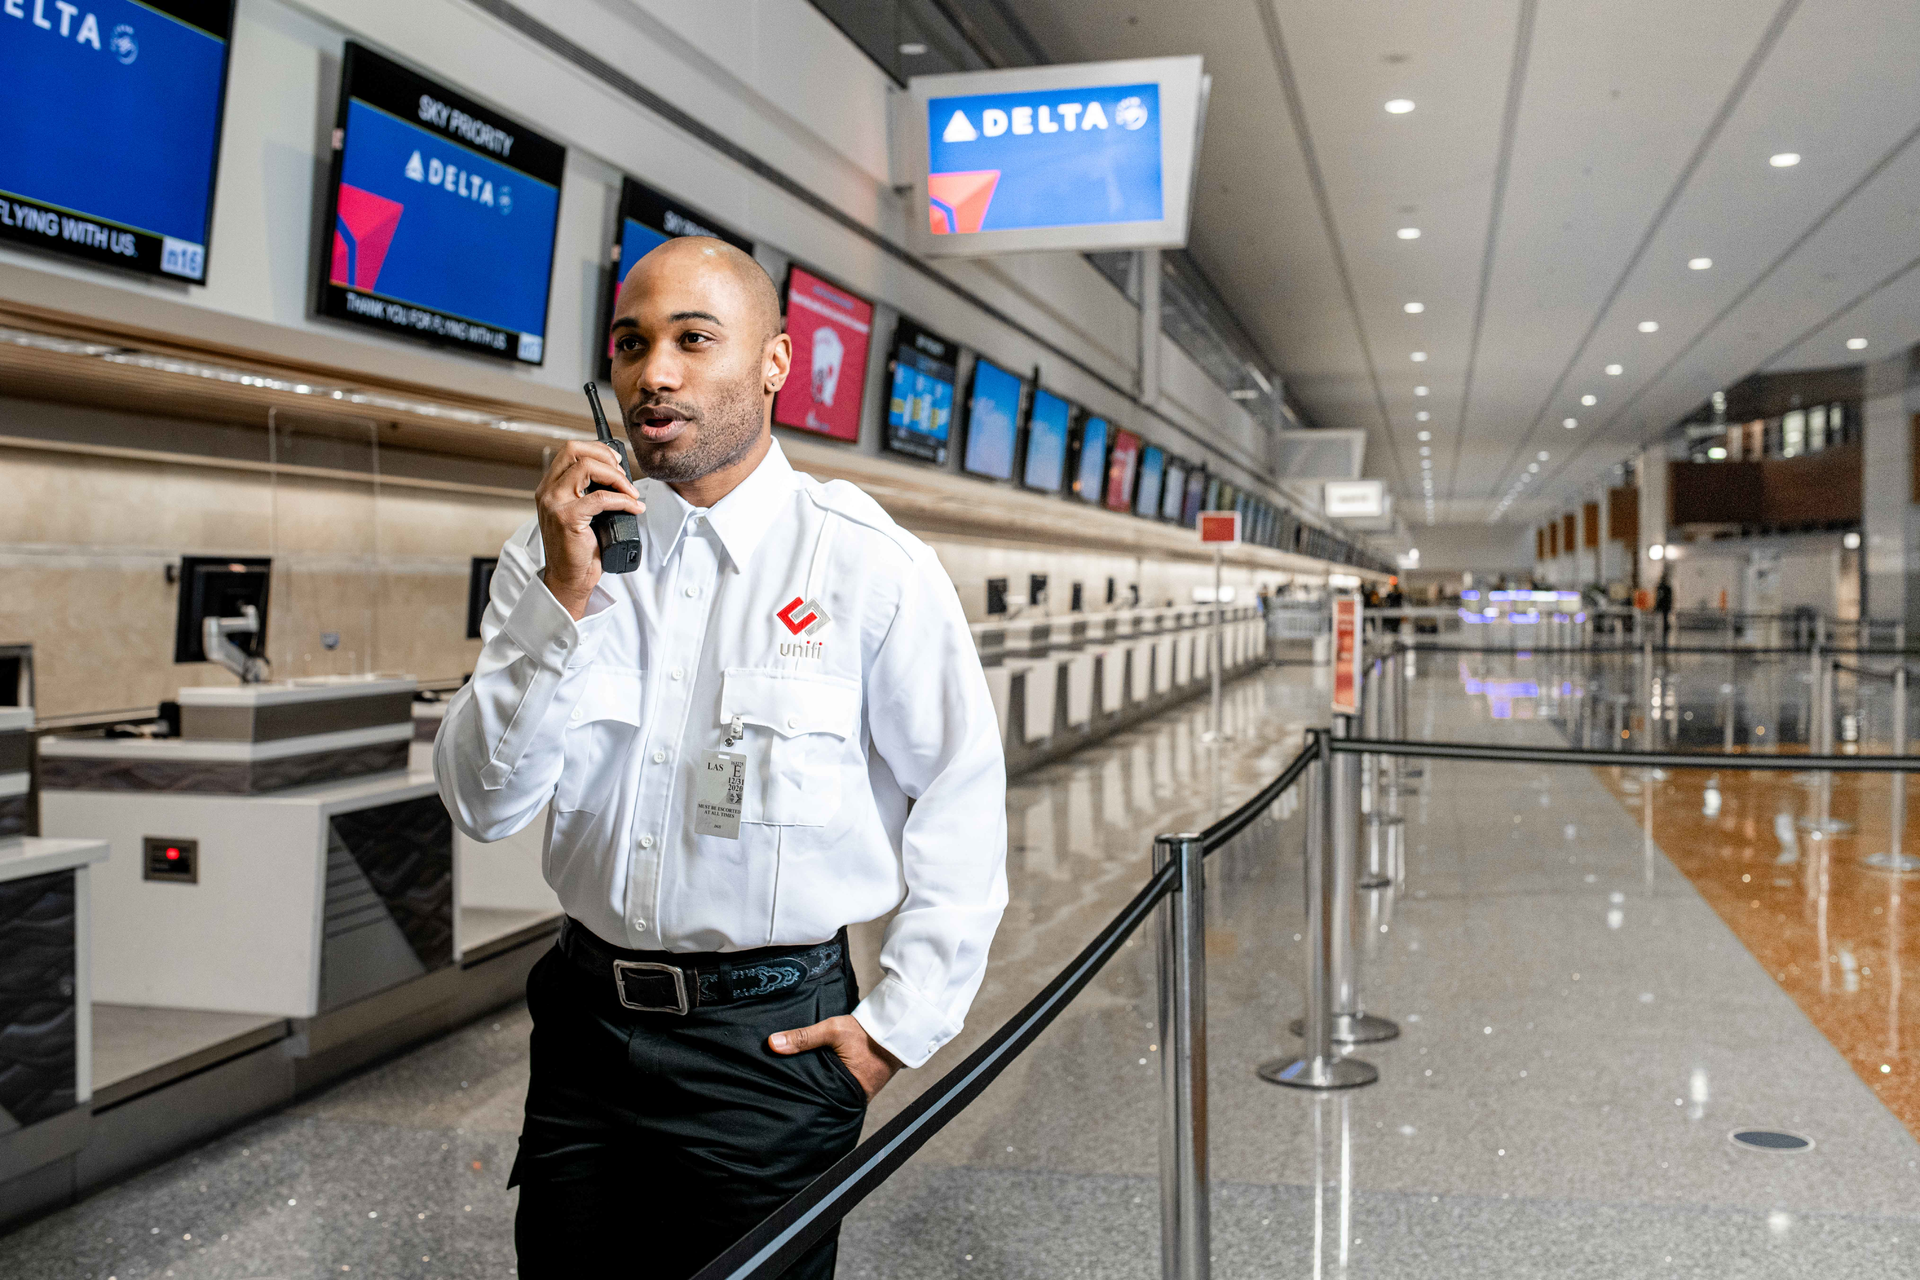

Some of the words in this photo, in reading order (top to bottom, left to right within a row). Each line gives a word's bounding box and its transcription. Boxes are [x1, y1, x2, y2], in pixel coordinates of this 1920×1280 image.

[418, 94, 451, 128] SKY
[449, 109, 514, 157] PRIORITY
[982, 101, 1109, 138] DELTA
[428, 157, 495, 208] DELTA
[61, 216, 109, 250] WITH
[345, 291, 385, 319] THANK
[385, 303, 408, 326] YOU
[780, 640, 822, 660] unifi
[707, 762, 724, 772] LAS
[733, 765, 742, 778] E
[728, 777, 744, 786] 12/31
[717, 806, 741, 815] ESCORTED
